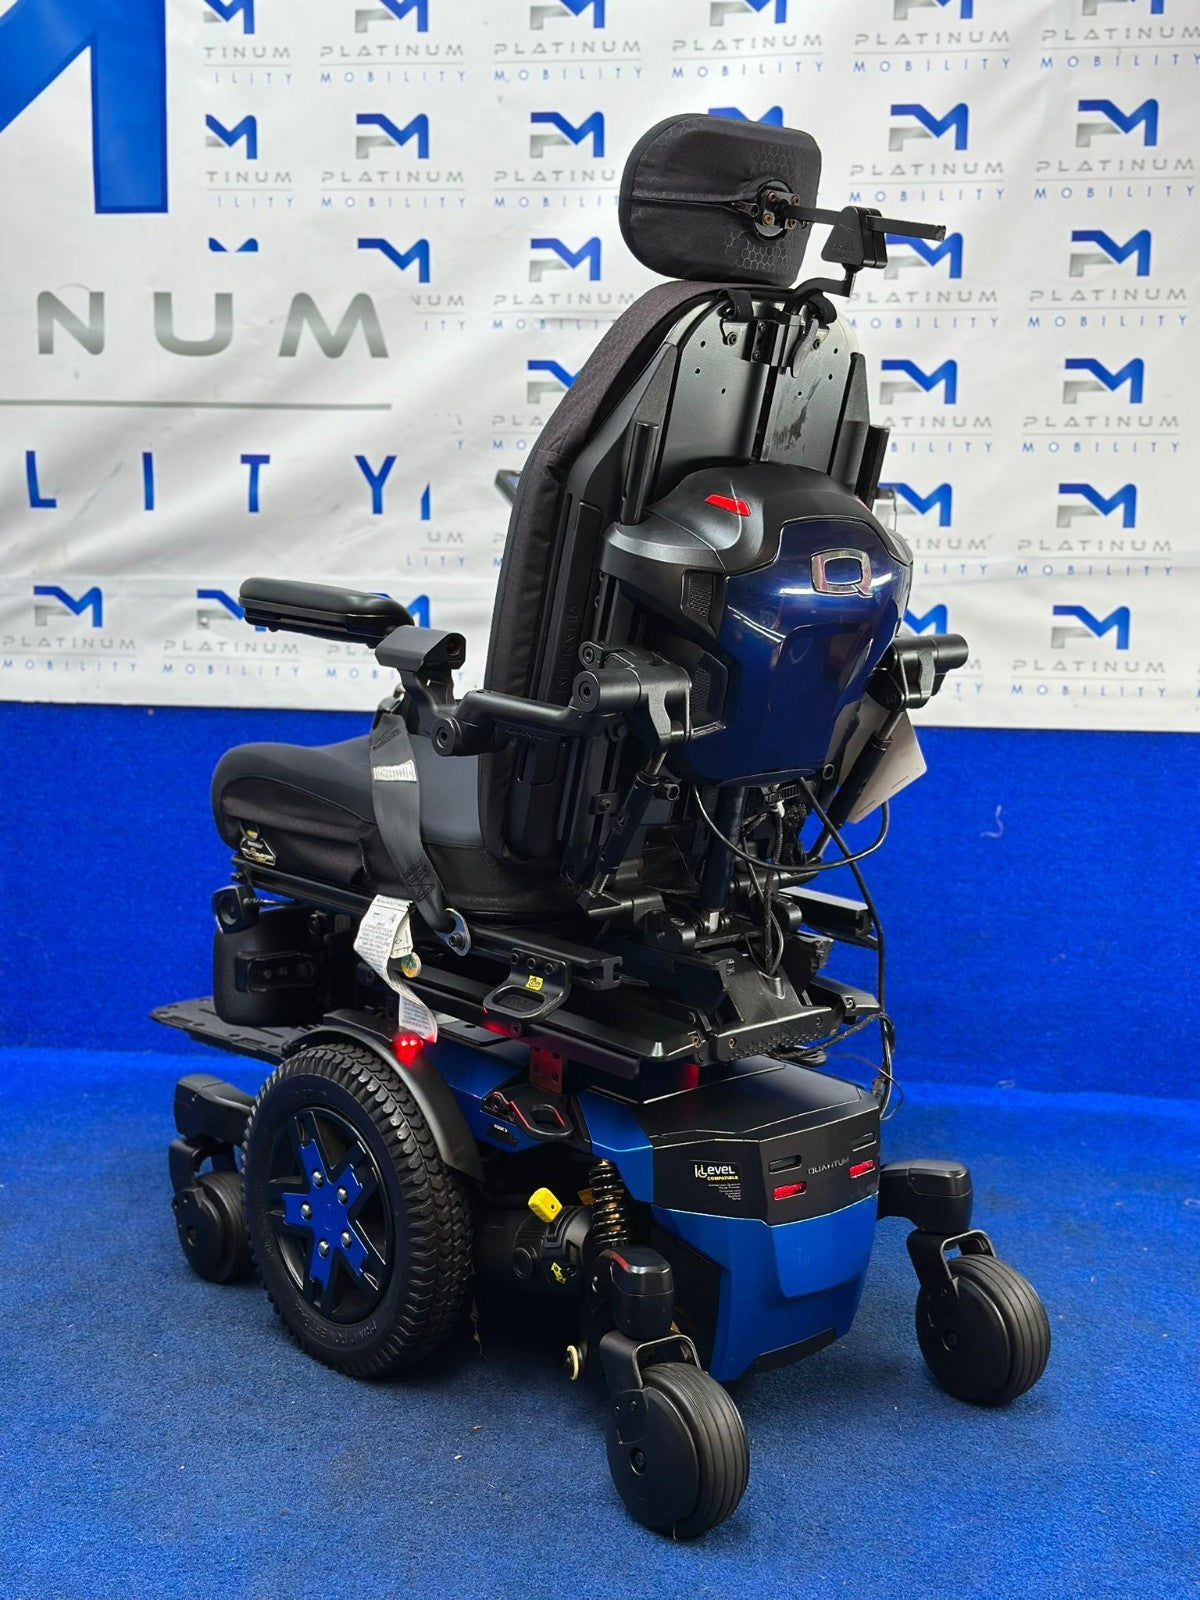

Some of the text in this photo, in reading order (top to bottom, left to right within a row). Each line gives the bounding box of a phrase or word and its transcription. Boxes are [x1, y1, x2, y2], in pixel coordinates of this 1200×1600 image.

[672, 35, 822, 52] PLATINUM
[854, 31, 1010, 46] PLATINUM
[321, 45, 464, 57] PLATINUM
[494, 40, 641, 54] PLATINUM
[672, 61, 824, 79] MOBILITY
[853, 57, 1012, 73] MOBILITY
[321, 71, 465, 83] MOBILITY
[494, 67, 643, 82] MOBILITY
[850, 161, 1004, 176] PLATINUM
[1036, 158, 1195, 174] PLATINUM
[321, 171, 464, 183] PLATINUM
[849, 189, 1004, 203] MOBILITY
[1035, 186, 1195, 200] MOBILITY
[321, 196, 465, 208] MOBILITY
[1030, 288, 1187, 302] PLATINUM
[37, 290, 389, 359] NUM
[492, 319, 617, 331] MOBILI
[1028, 315, 1188, 329] MOBILITY
[1022, 416, 1180, 429] PLATINUM
[1022, 440, 1180, 454] MOBILITY
[26, 450, 397, 515] LITY
[905, 539, 987, 550] INUM
[1018, 539, 1173, 552] PLATINUM
[1017, 563, 1173, 577] MOBILITY
[2, 636, 137, 650] PLATINUM
[163, 641, 299, 655] PLATINUM
[2, 659, 137, 672] MOBILITY
[163, 663, 299, 676] MOBILITY
[1013, 659, 1167, 673] PLATINUM
[1012, 685, 1167, 698] MOBILITY
